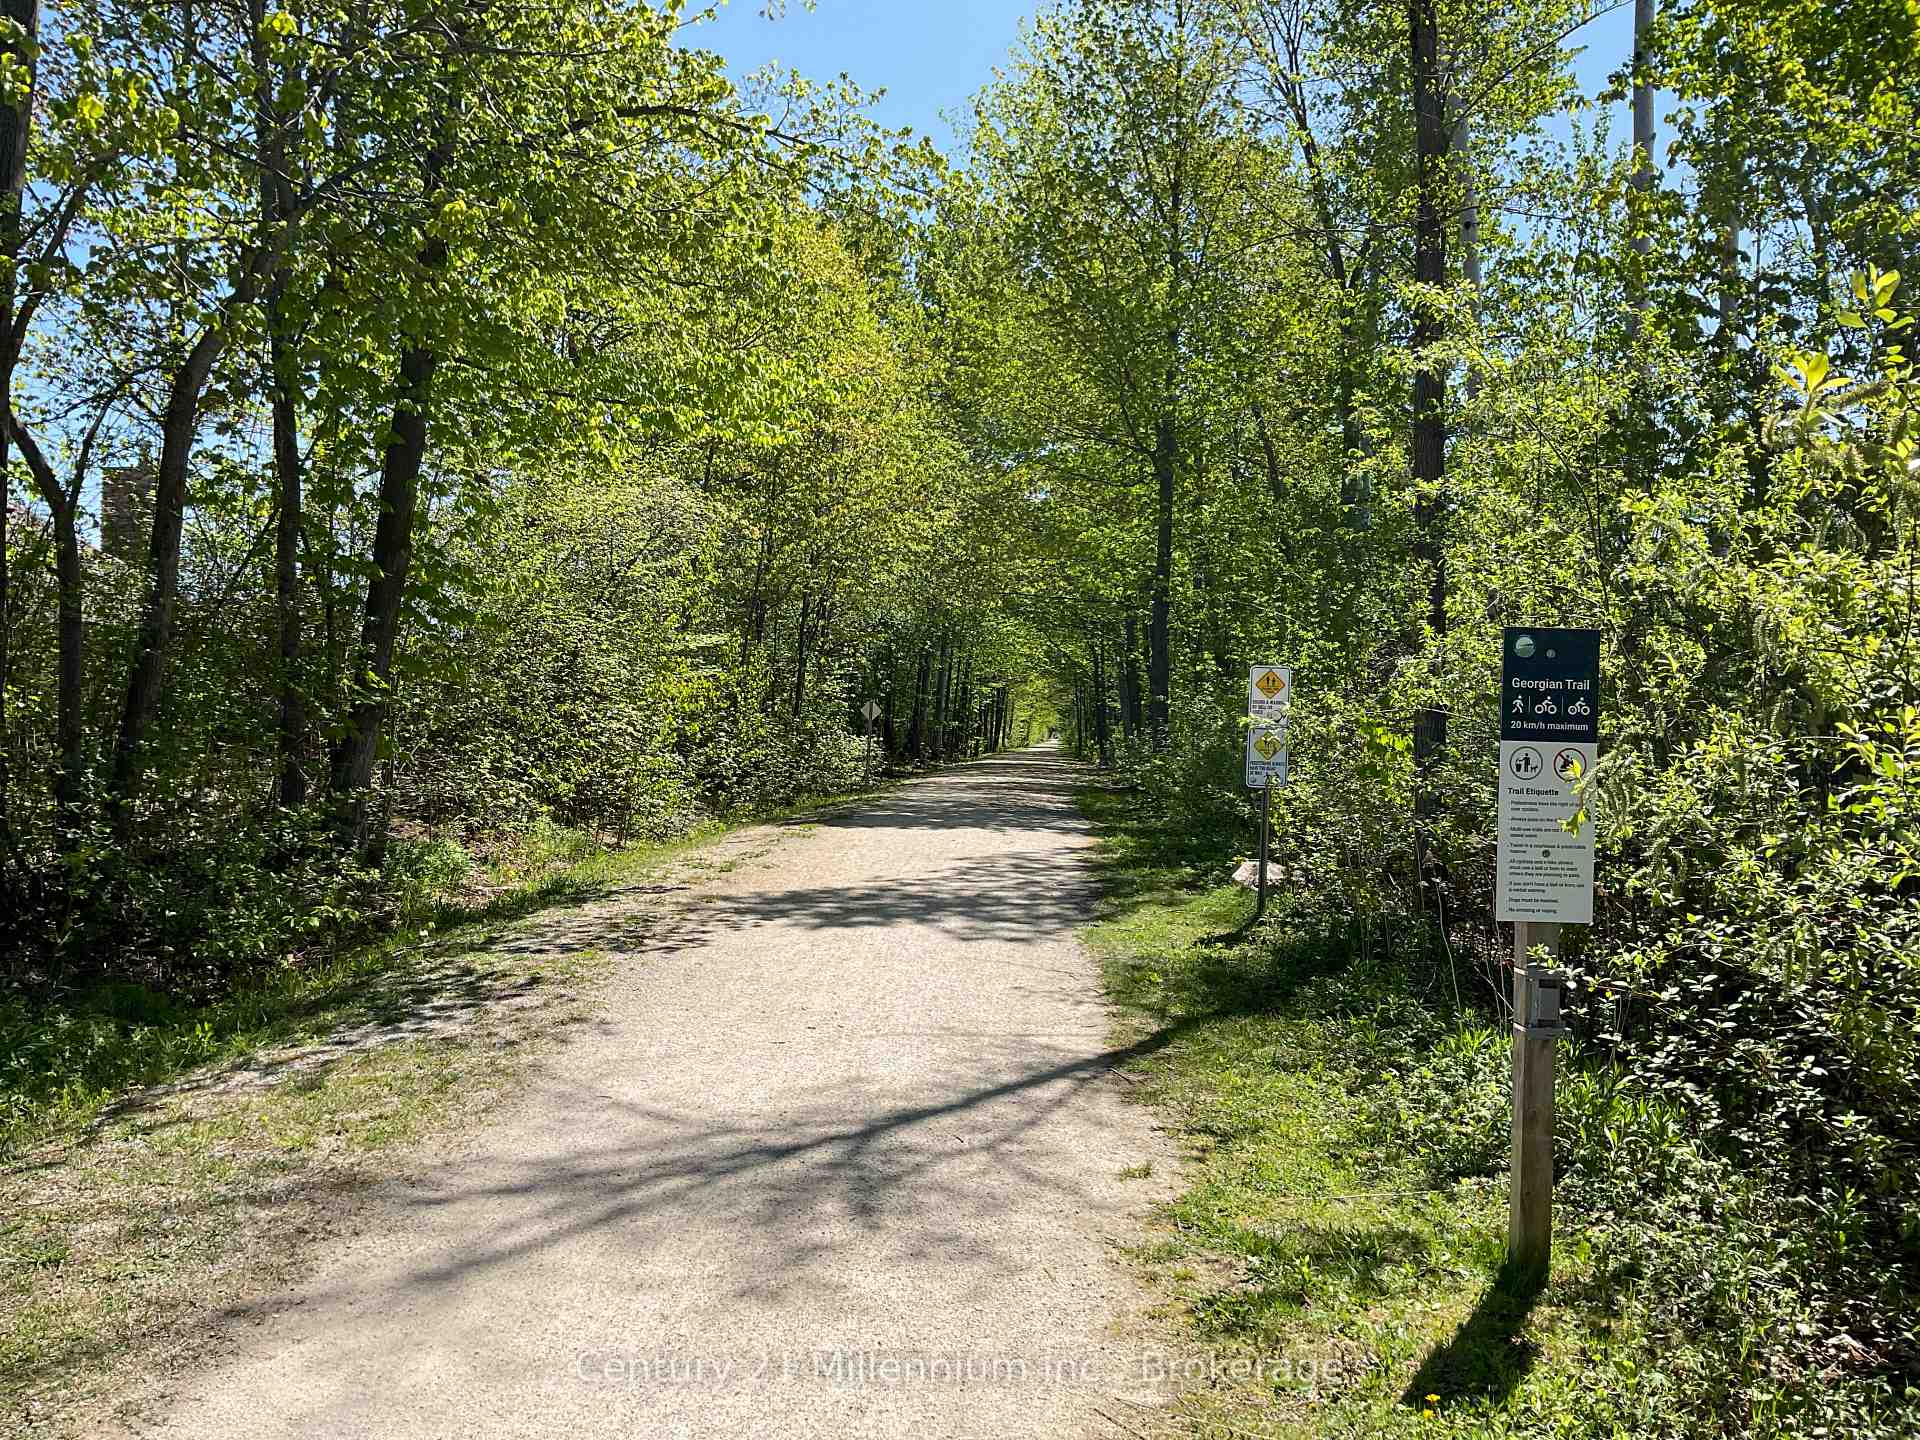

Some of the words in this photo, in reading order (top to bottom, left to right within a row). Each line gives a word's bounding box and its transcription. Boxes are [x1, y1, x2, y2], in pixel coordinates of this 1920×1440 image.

[1511, 677, 1563, 691] Georgian
[1565, 679, 1590, 690] Trail
[1510, 720, 1521, 729] 20
[1523, 720, 1545, 730] km/h
[1547, 721, 1589, 731] maximum
[1507, 787, 1524, 795] Trail
[1525, 787, 1559, 797] Etiquette
